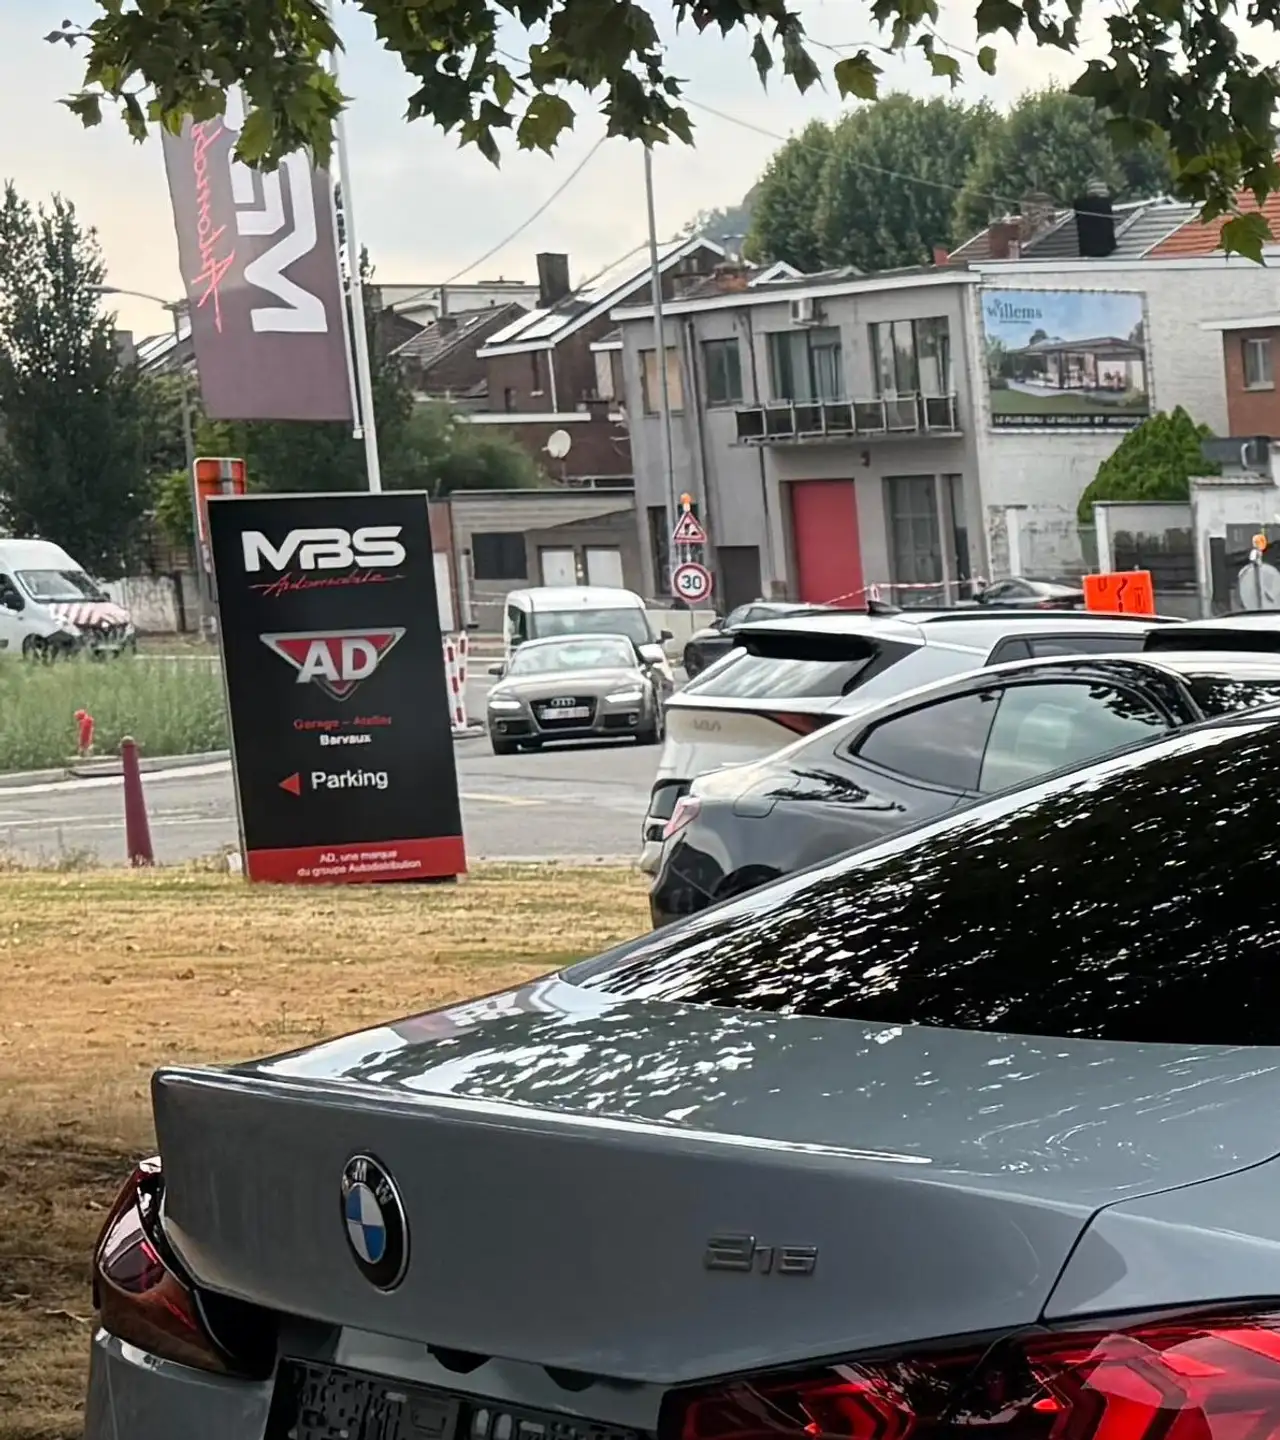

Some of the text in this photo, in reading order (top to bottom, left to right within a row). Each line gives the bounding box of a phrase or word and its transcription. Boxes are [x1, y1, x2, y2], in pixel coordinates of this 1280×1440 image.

[241, 525, 406, 573] MBS
[681, 574, 702, 590] 30
[296, 639, 378, 683] AD
[311, 769, 389, 790] Parking
